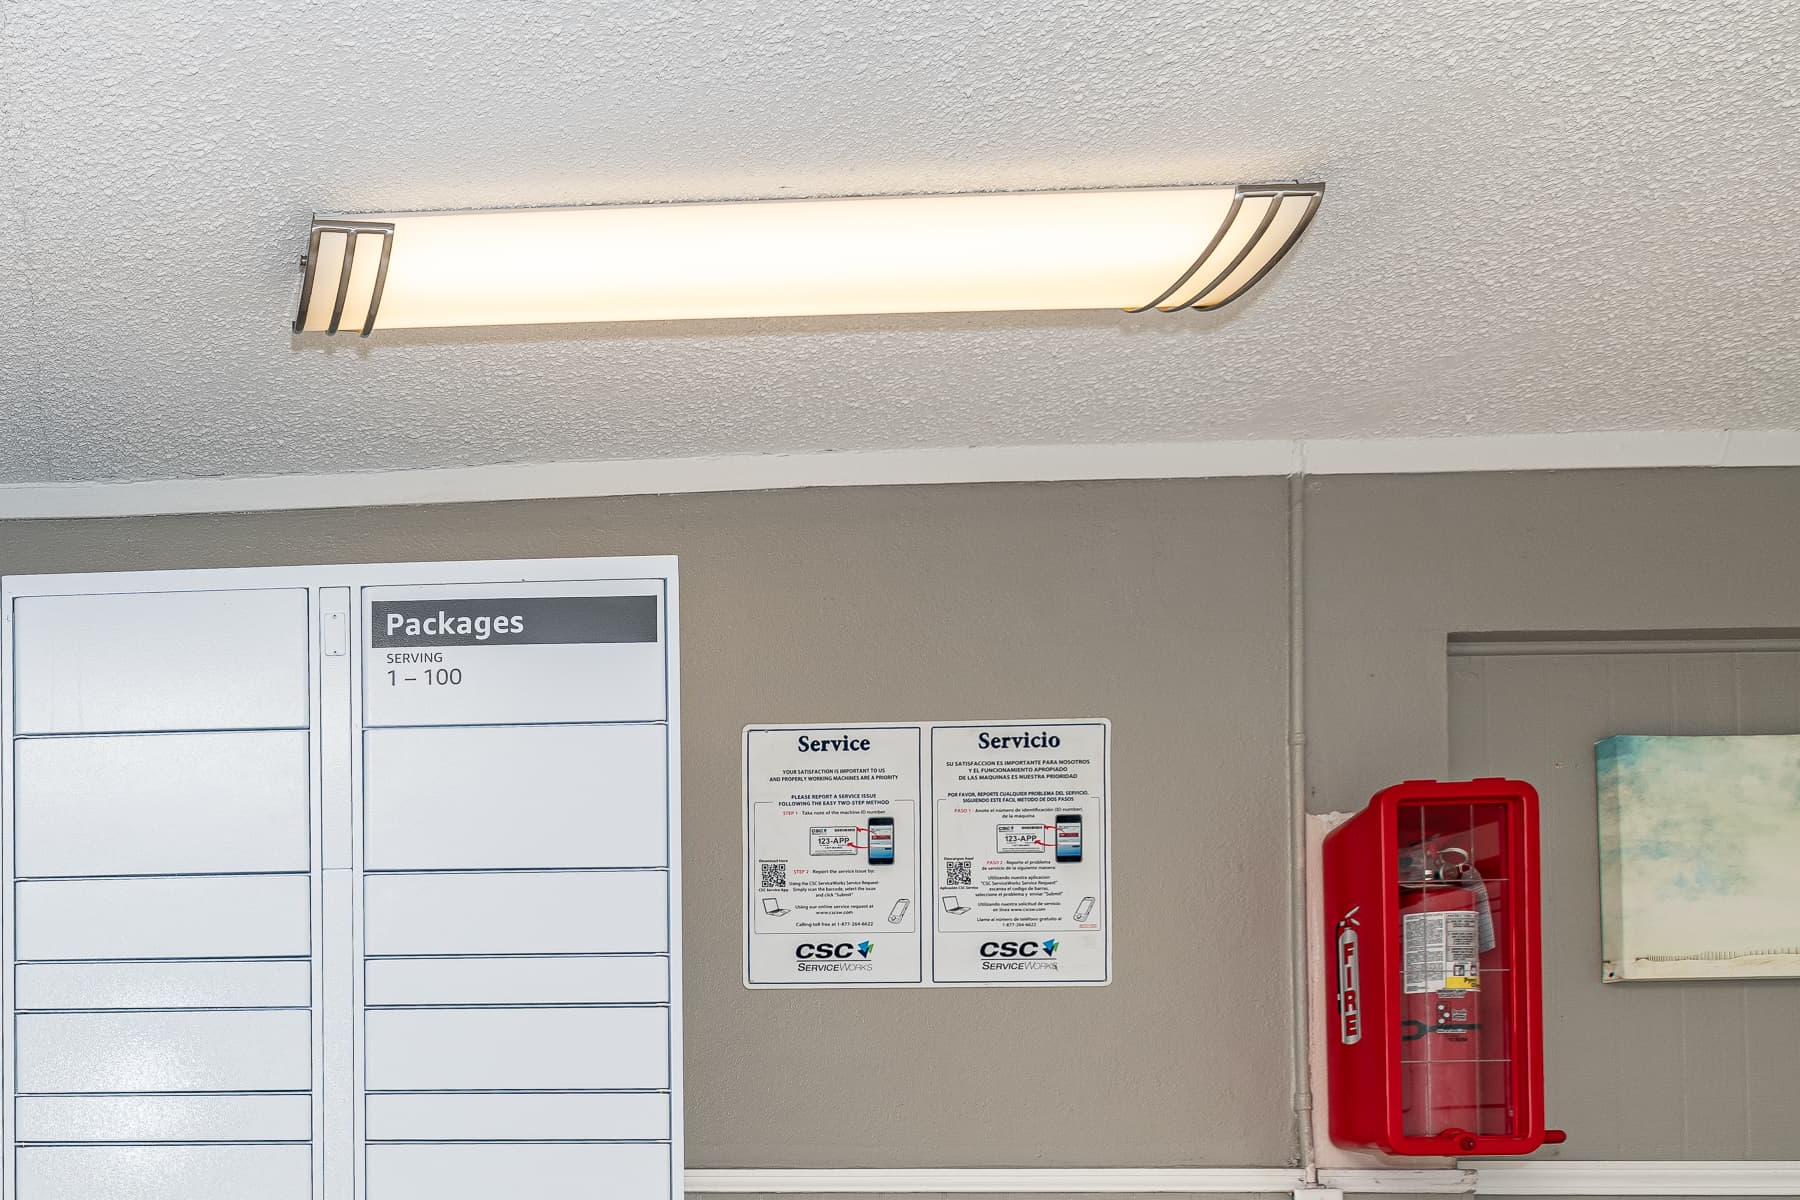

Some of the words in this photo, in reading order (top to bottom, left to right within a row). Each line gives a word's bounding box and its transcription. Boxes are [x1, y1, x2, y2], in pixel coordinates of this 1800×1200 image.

[387, 611, 524, 640] Packages
[387, 652, 443, 664] SERVING
[388, 670, 396, 686] 1
[424, 668, 462, 686] 100
[798, 735, 871, 752] Service
[978, 732, 1060, 749] Servicio
[795, 943, 854, 959] CSC
[980, 941, 1039, 957] CSC
[1344, 943, 1357, 1036] FIRE
